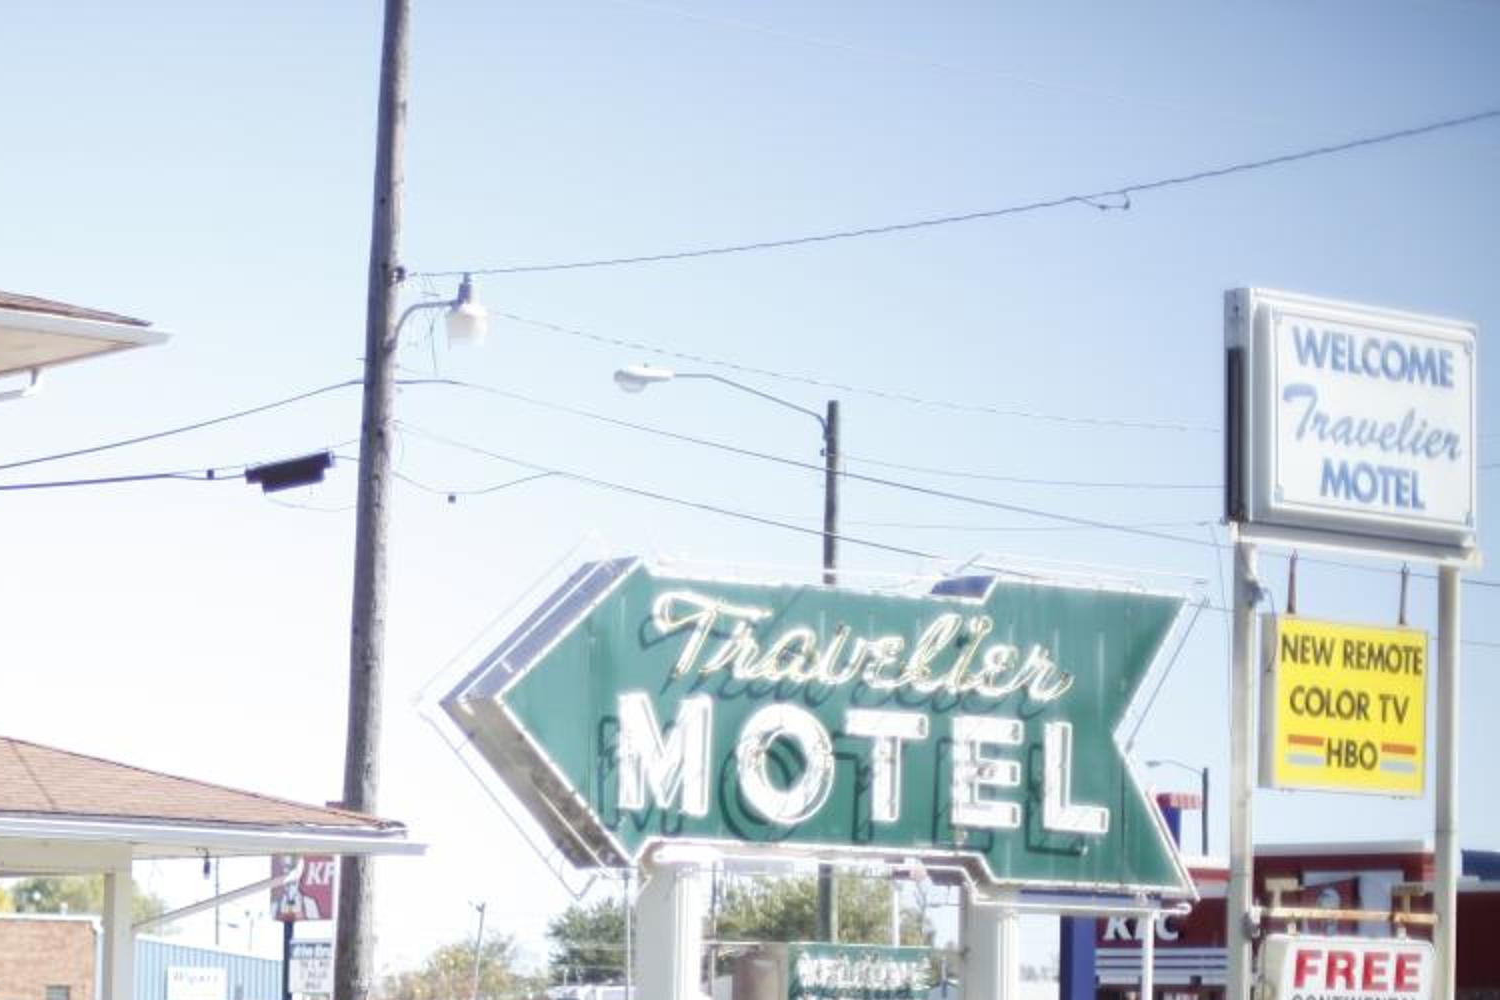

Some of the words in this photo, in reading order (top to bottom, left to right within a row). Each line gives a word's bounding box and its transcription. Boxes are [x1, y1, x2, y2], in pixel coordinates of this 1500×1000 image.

[1293, 326, 1454, 389] WELCOME
[1283, 383, 1461, 460] Travelier
[1320, 457, 1426, 510] MOTEL
[652, 590, 1075, 701] Travelier
[1281, 634, 1336, 668] NEW
[1343, 639, 1423, 677] REMOTE
[1289, 685, 1371, 722] COLOR
[1379, 693, 1411, 725] TV
[616, 692, 1111, 836] MOTEL
[1326, 737, 1379, 771] HBO
[304, 860, 335, 886] KF
[1293, 949, 1422, 993] FREE
